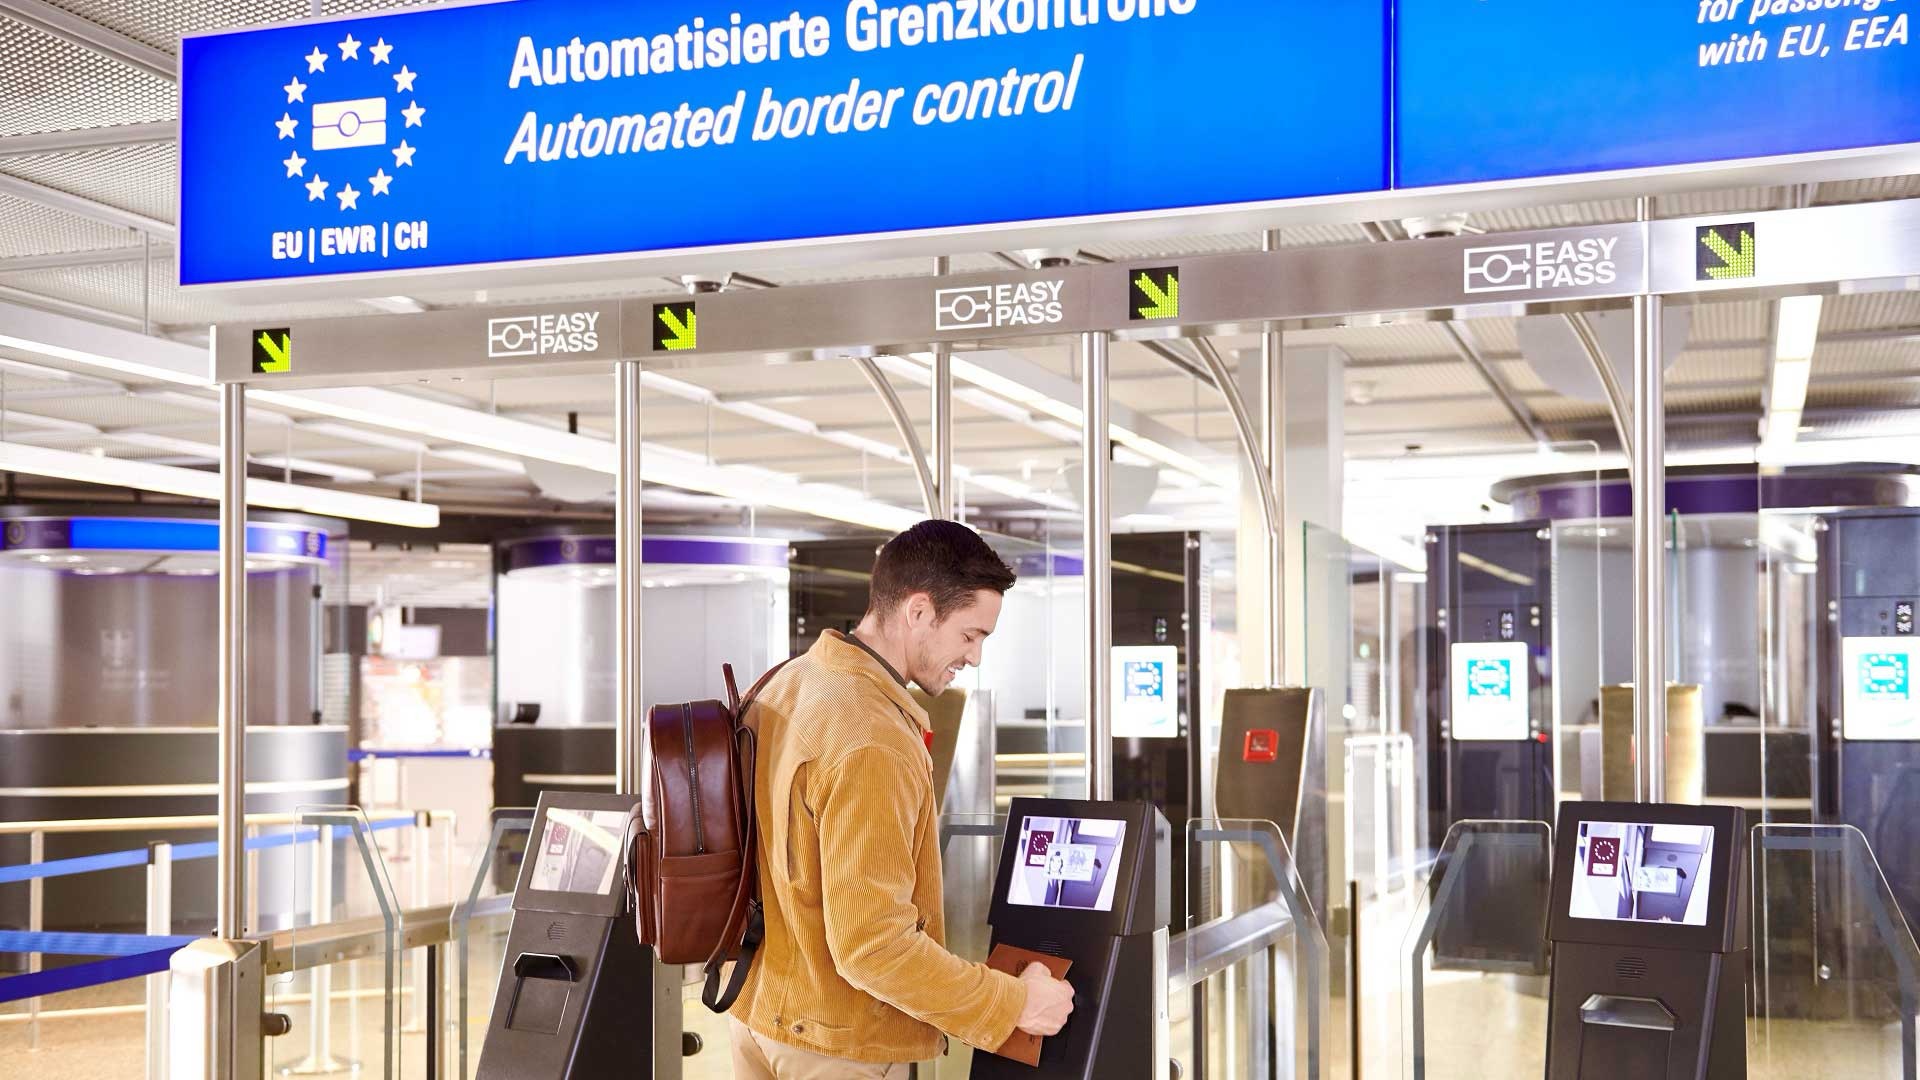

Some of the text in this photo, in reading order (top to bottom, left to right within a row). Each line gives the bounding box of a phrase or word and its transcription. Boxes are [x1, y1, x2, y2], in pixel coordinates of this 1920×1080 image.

[1697, 0, 1744, 23] for
[509, 11, 830, 88] Automatisierte
[1698, 13, 1909, 67] with EU, EEA
[503, 53, 1084, 165] Automated border control
[272, 230, 303, 260] EU
[321, 225, 376, 256] EWR
[394, 220, 428, 251] CH
[1535, 236, 1618, 265] EASY
[1535, 261, 1617, 289] PASS
[995, 280, 1064, 305] EASY
[540, 311, 599, 334] EASY
[995, 301, 1063, 327] PASS
[540, 331, 599, 354] PASS
